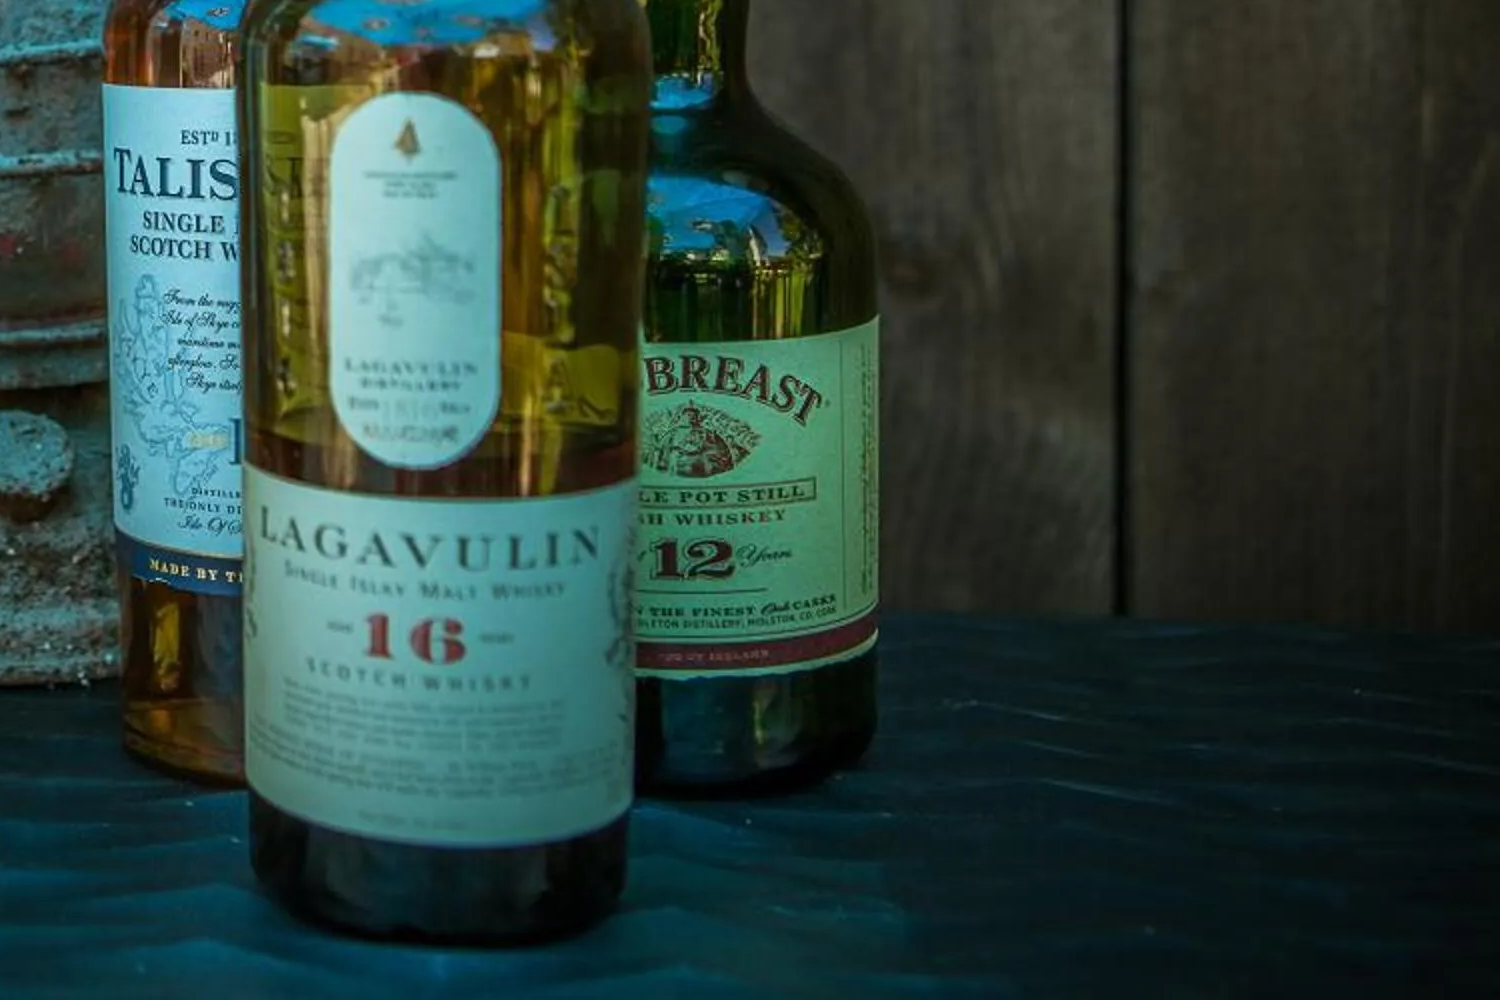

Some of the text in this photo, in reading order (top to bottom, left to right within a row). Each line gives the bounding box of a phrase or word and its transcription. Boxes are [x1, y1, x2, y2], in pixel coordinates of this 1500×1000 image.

[143, 209, 226, 234] SINGLE
[129, 235, 211, 260] SCOTCH
[189, 500, 221, 514] ONLY
[679, 489, 729, 505] POT
[737, 484, 805, 504] STILL
[676, 508, 786, 527] WHISKEY
[260, 505, 600, 572] LAGAVULIN
[150, 559, 190, 578] MADE
[197, 567, 219, 582] BY
[651, 536, 737, 582] 12
[283, 558, 339, 590] SINGLE
[418, 579, 479, 601] MALT
[491, 580, 568, 599] WHISKY
[362, 609, 468, 667] 16
[305, 656, 533, 693] SCOTCH WHISKY
